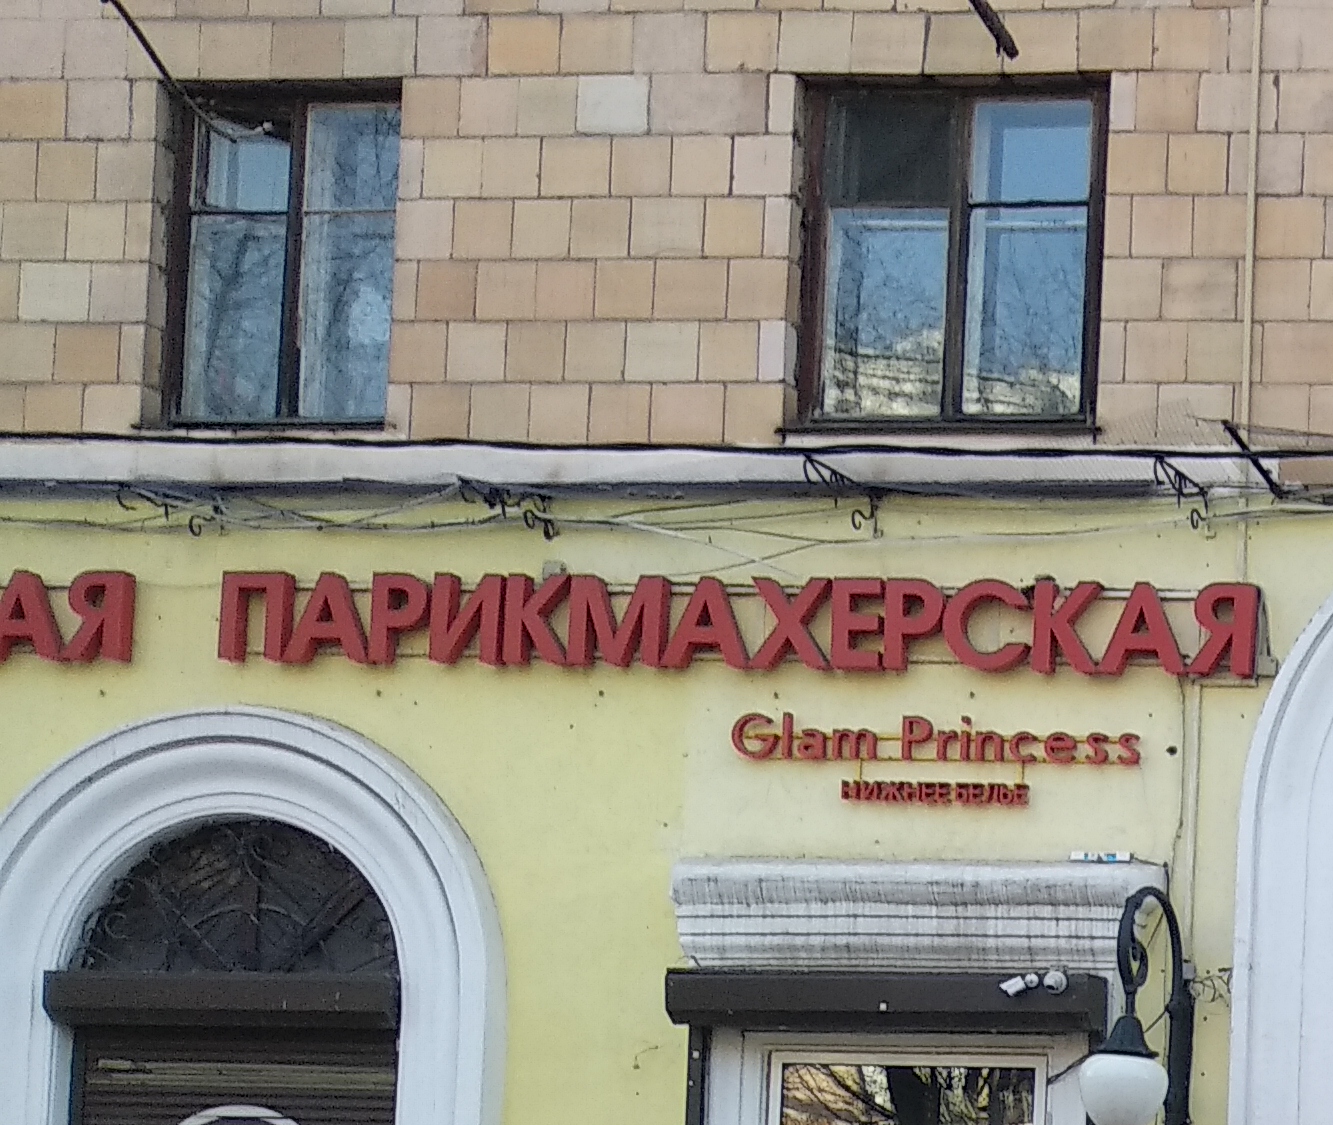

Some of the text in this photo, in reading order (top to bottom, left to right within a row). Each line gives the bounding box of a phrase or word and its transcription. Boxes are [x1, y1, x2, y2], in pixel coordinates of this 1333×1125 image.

[218, 570, 1260, 679] ПАРИКМАХЕРСКАЯ
[731, 711, 1140, 766] Glam Princess
[840, 780, 1029, 807] НИЖНЕЕ БЕЛЬЕ
